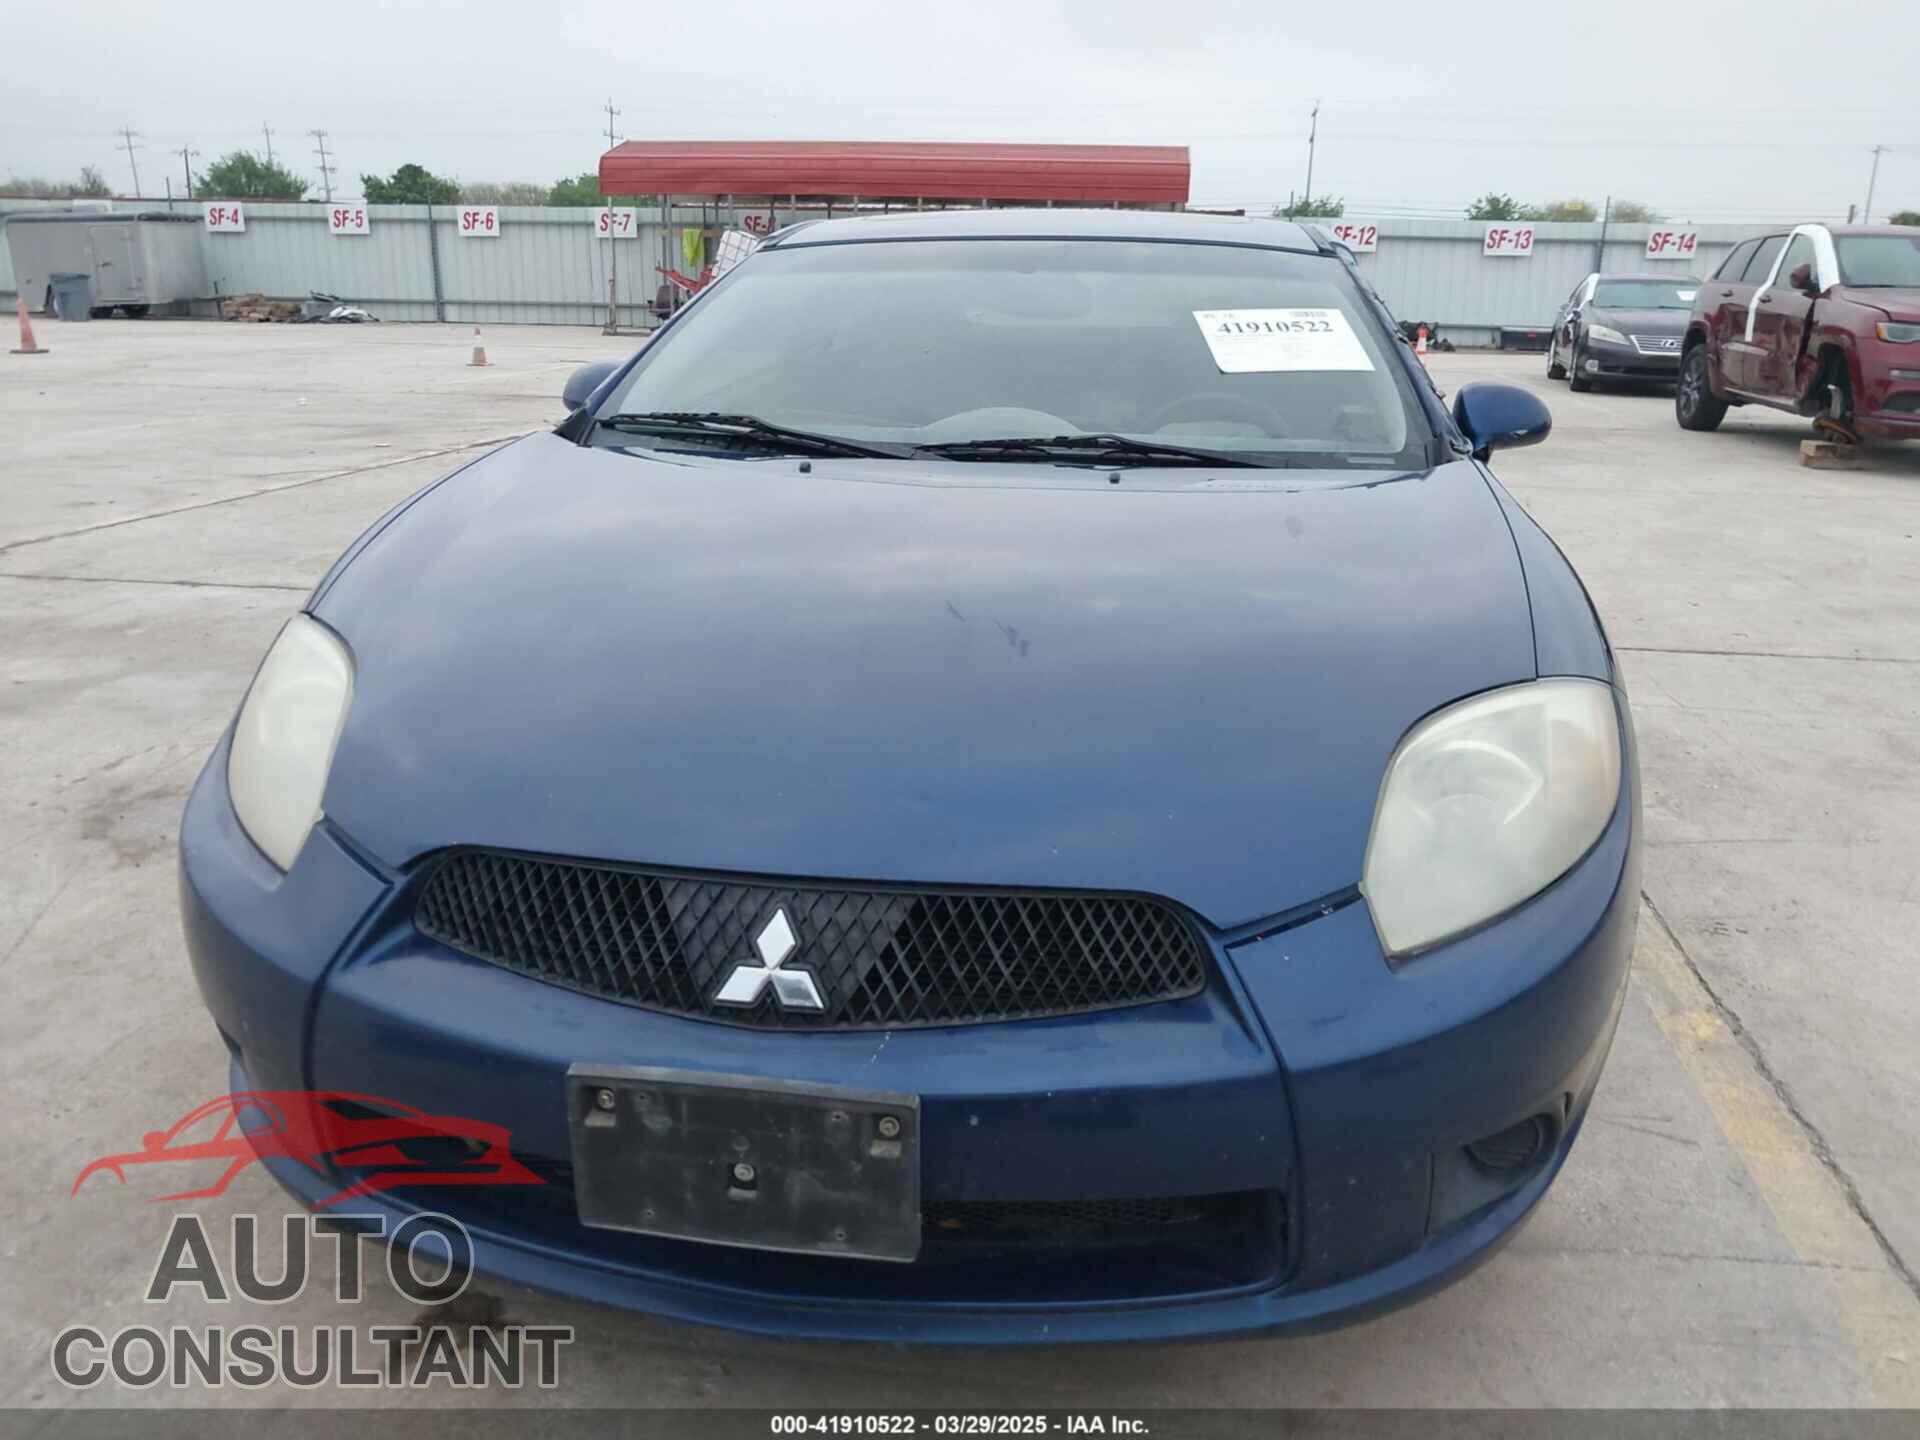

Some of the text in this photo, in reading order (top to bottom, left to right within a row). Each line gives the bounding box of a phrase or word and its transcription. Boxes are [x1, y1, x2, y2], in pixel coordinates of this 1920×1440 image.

[209, 206, 240, 224] SF-4
[332, 209, 364, 227] SF-5
[463, 211, 495, 230] SF-6
[599, 213, 631, 232] SF-7
[1487, 229, 1534, 250] SF-13
[1648, 232, 1696, 253] SF-14
[1218, 320, 1334, 334] 41910522
